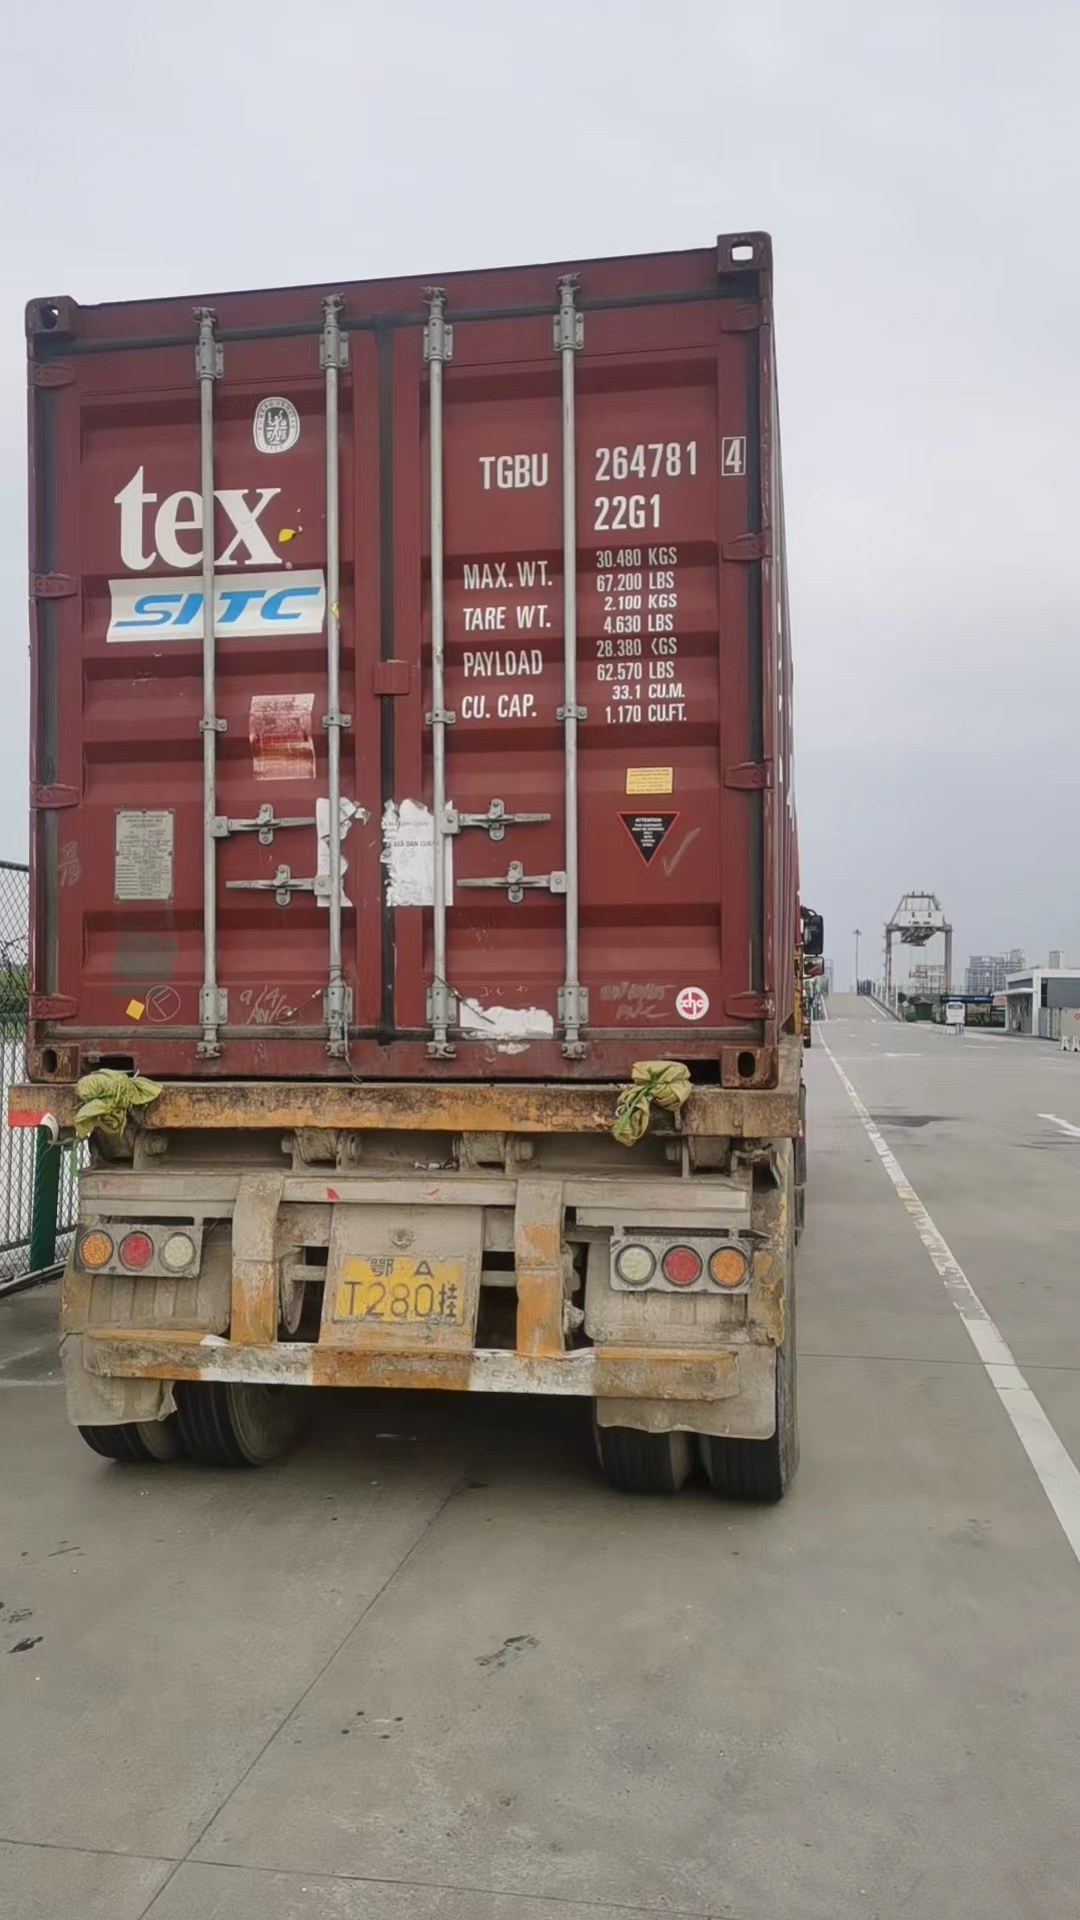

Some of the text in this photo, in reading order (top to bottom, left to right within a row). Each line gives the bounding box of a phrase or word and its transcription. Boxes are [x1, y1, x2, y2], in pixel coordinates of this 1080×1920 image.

[479, 438, 742, 490] TGBU 264781 4
[114, 465, 283, 571] tex
[594, 494, 660, 531] 22G1
[596, 547, 677, 568] 30.480 KGS
[463, 560, 553, 590] MAX. WT.
[596, 572, 674, 592] 67.200 LBS
[113, 587, 322, 628] SITC
[604, 593, 677, 611] 2.100 KGS
[463, 605, 551, 631] TARE WT.
[603, 614, 674, 634] 4.630 LBS
[596, 638, 641, 658] 28.380
[463, 650, 543, 677] PAYLOAD
[597, 661, 674, 681] 62.570 LBS
[612, 683, 685, 700] 33.1 CU.M.
[462, 694, 537, 719] CU. CAP.
[605, 703, 687, 724] 1.170 CU.FT.
[413, 1260, 434, 1279] A
[344, 1281, 458, 1317] T280挂
